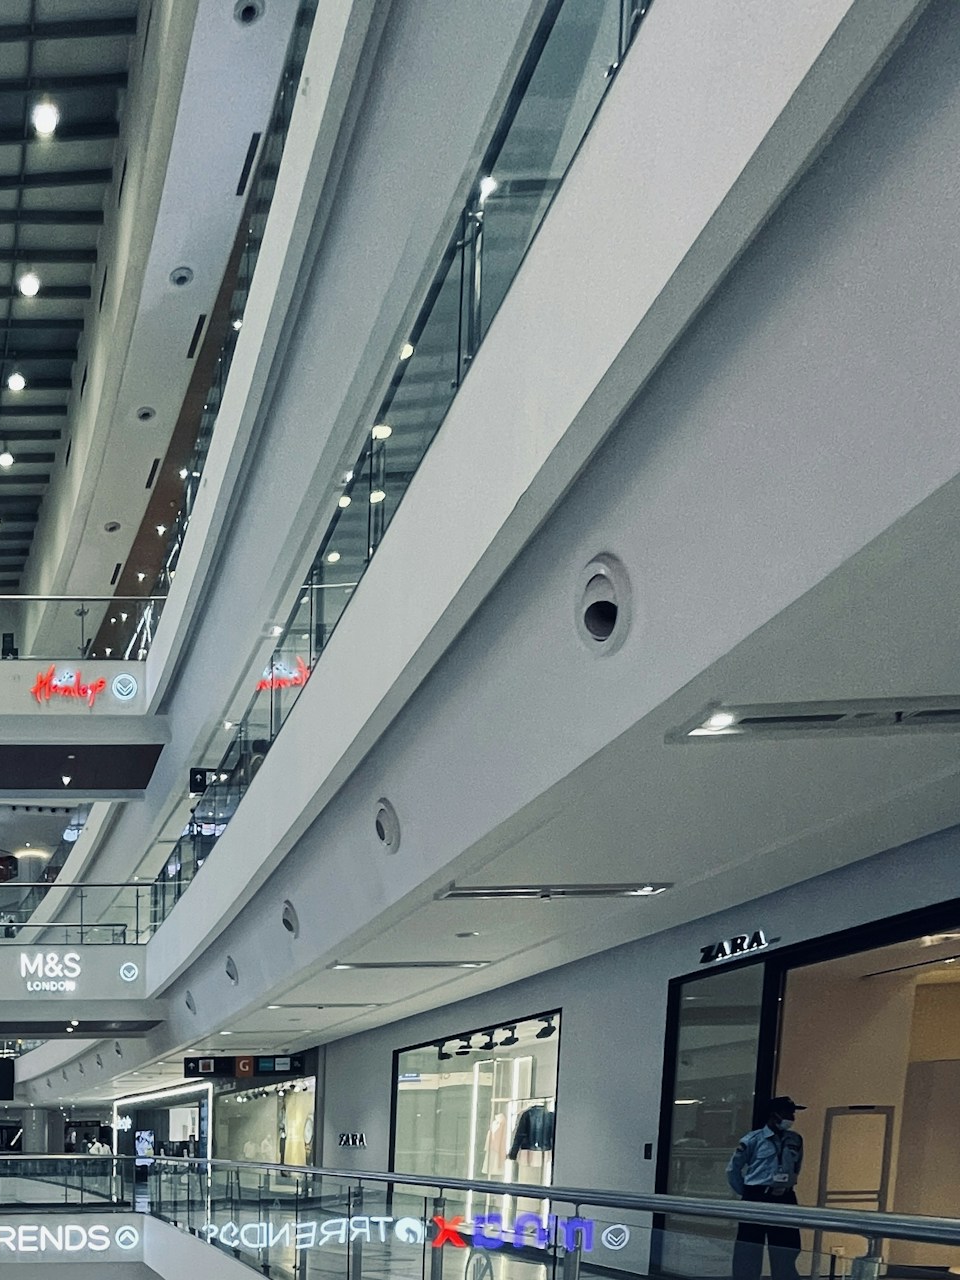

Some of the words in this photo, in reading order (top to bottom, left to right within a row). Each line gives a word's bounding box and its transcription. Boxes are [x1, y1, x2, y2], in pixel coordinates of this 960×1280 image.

[31, 663, 106, 708] Hamleys
[700, 929, 768, 964] ZARA
[20, 953, 81, 978] M&S
[26, 981, 76, 992] LONDON
[239, 1059, 249, 1072] G
[339, 1132, 367, 1147] ZARA
